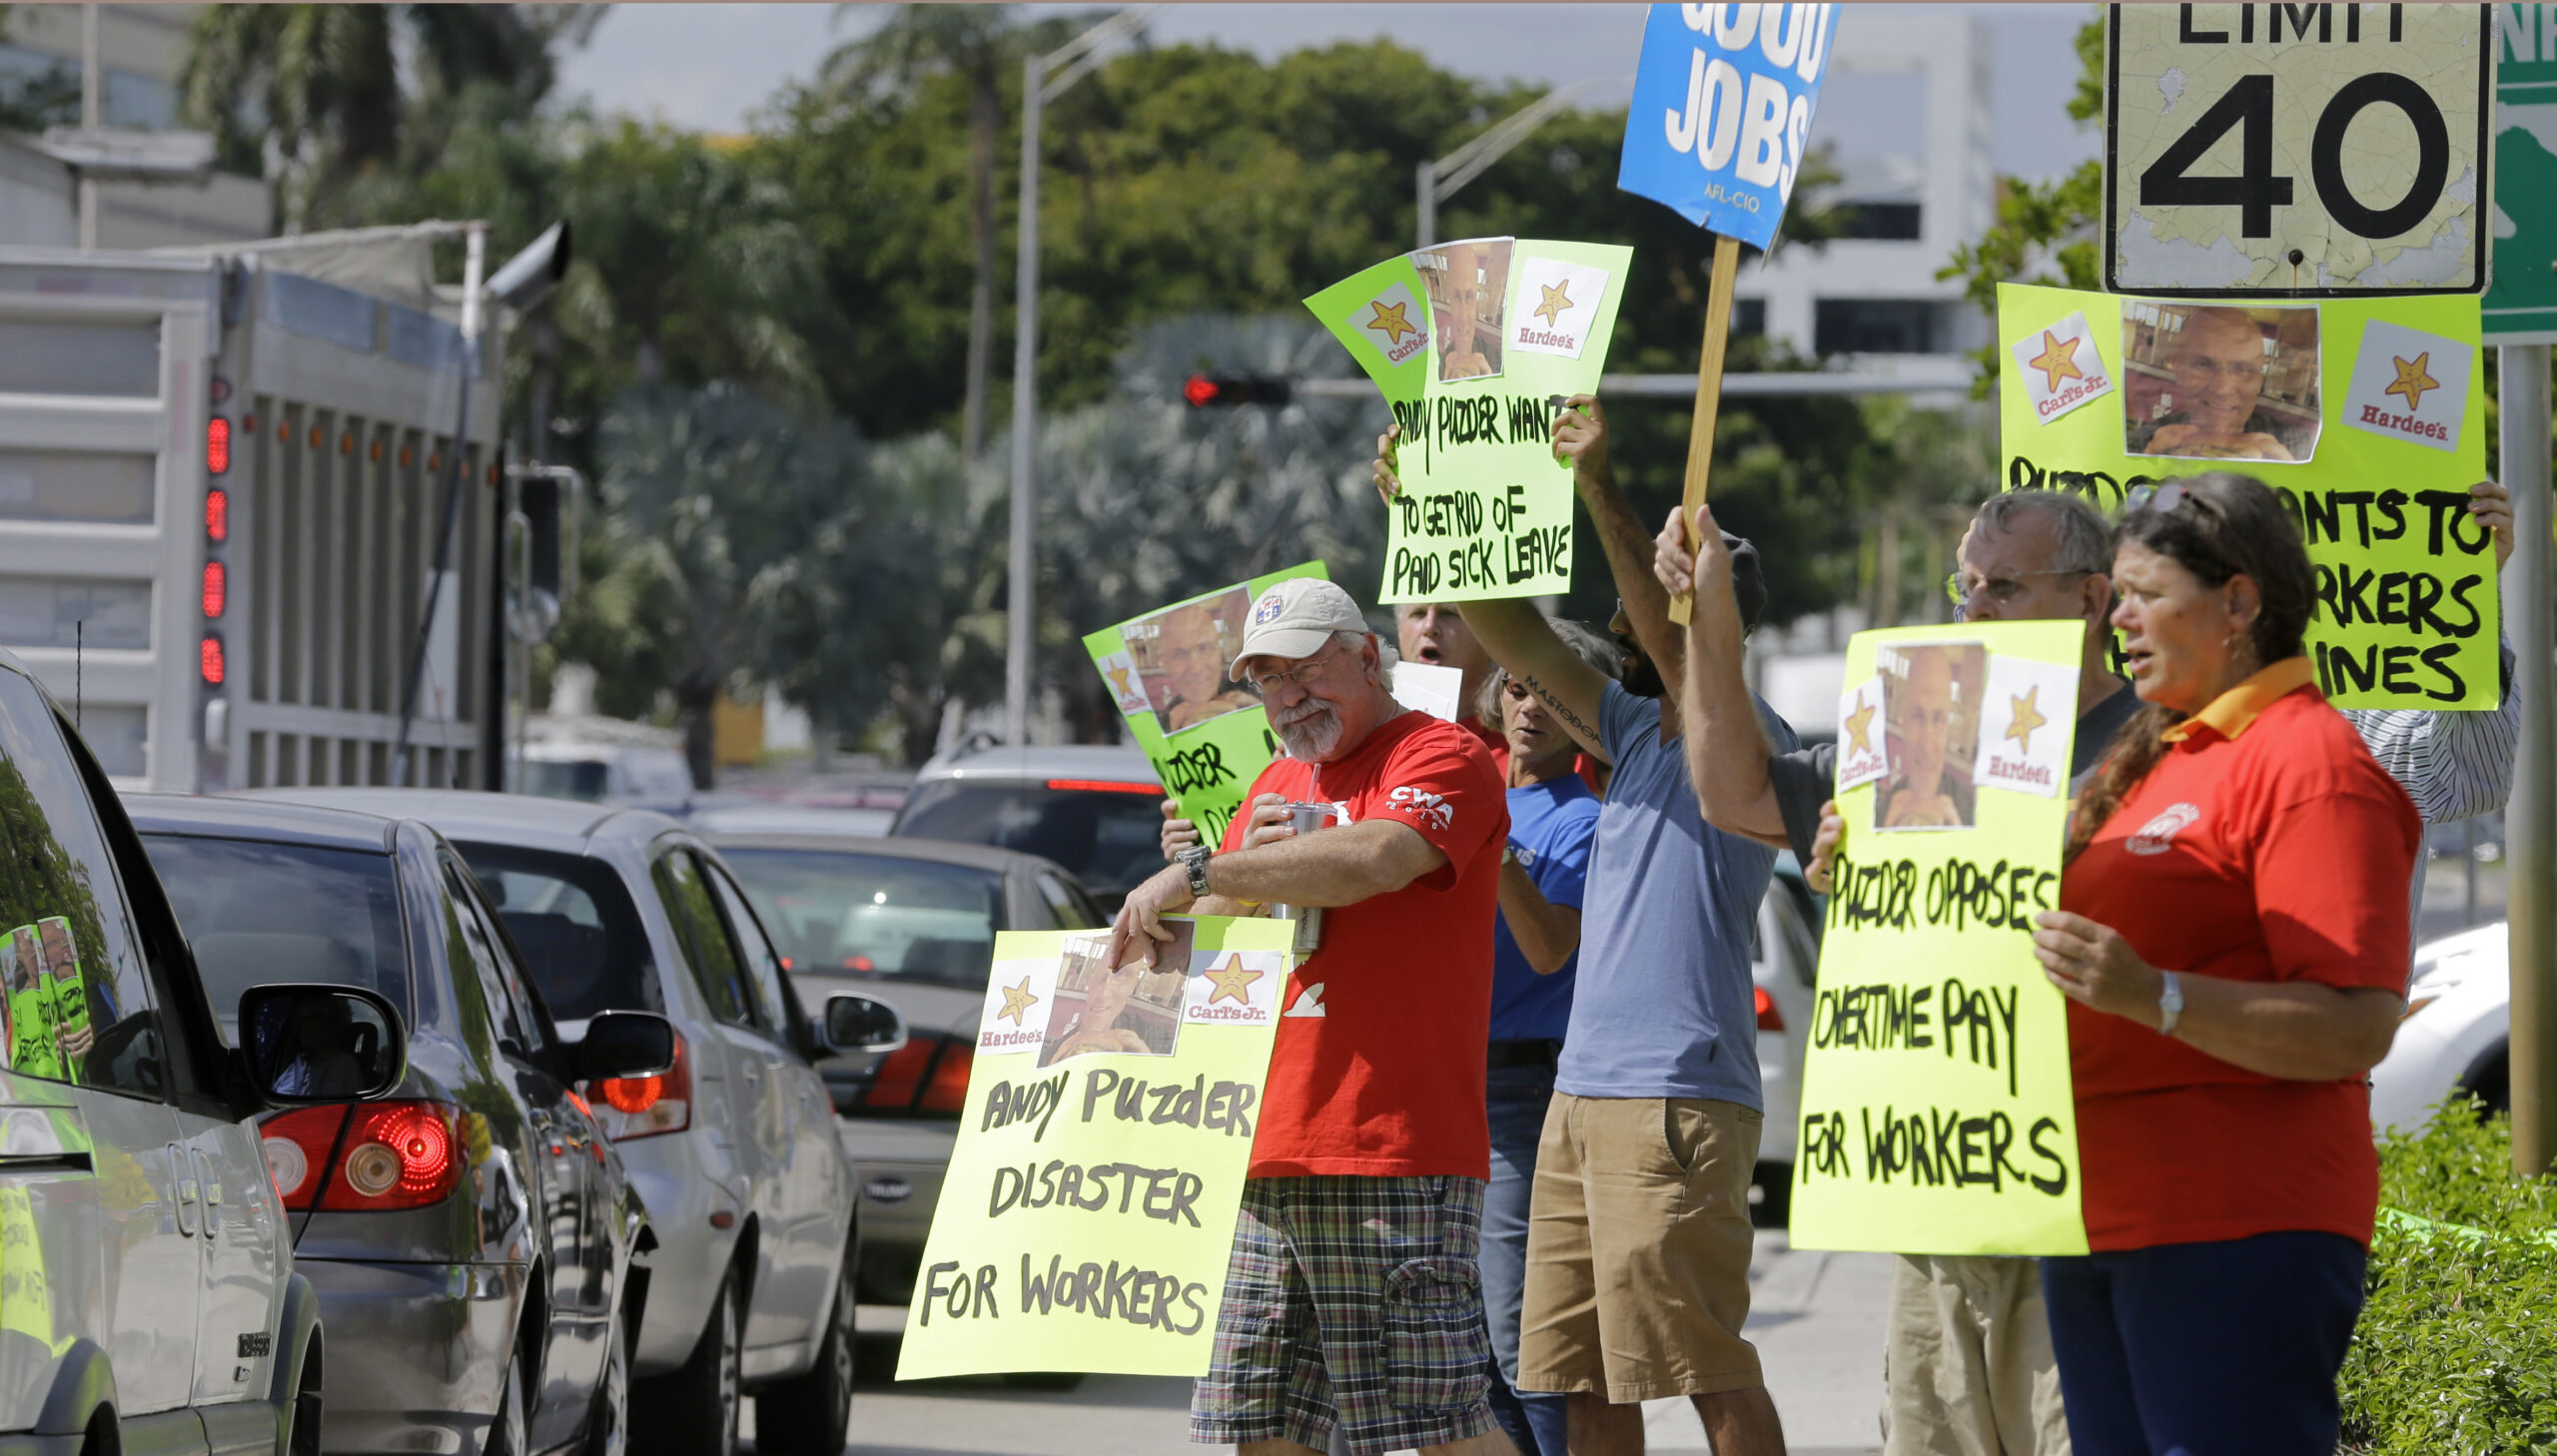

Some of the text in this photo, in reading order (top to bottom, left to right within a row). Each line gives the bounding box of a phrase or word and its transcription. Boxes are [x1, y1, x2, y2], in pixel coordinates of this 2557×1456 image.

[1665, 47, 1809, 206] JOBS
[2139, 72, 2449, 239] 40
[1704, 183, 1760, 213] AFL-CIO
[1393, 394, 1580, 475] ANDY PUZDER WANT
[1393, 494, 1419, 537] TO
[1493, 485, 1526, 533] OF
[1392, 524, 1570, 596] PAID SICK LEAVE
[1389, 786, 1453, 824] CWA
[1831, 852, 2058, 934] PUZDER OPPOSES
[1189, 1006, 1267, 1021] Carl's Jr.
[1815, 977, 2018, 1097] OVERTIME PAY
[981, 1071, 1070, 1142] ANDY
[1804, 1105, 2068, 1195] FOR WORKERS
[989, 1159, 1204, 1227] DISASTER
[921, 1253, 1209, 1335] FOR WORKERS
